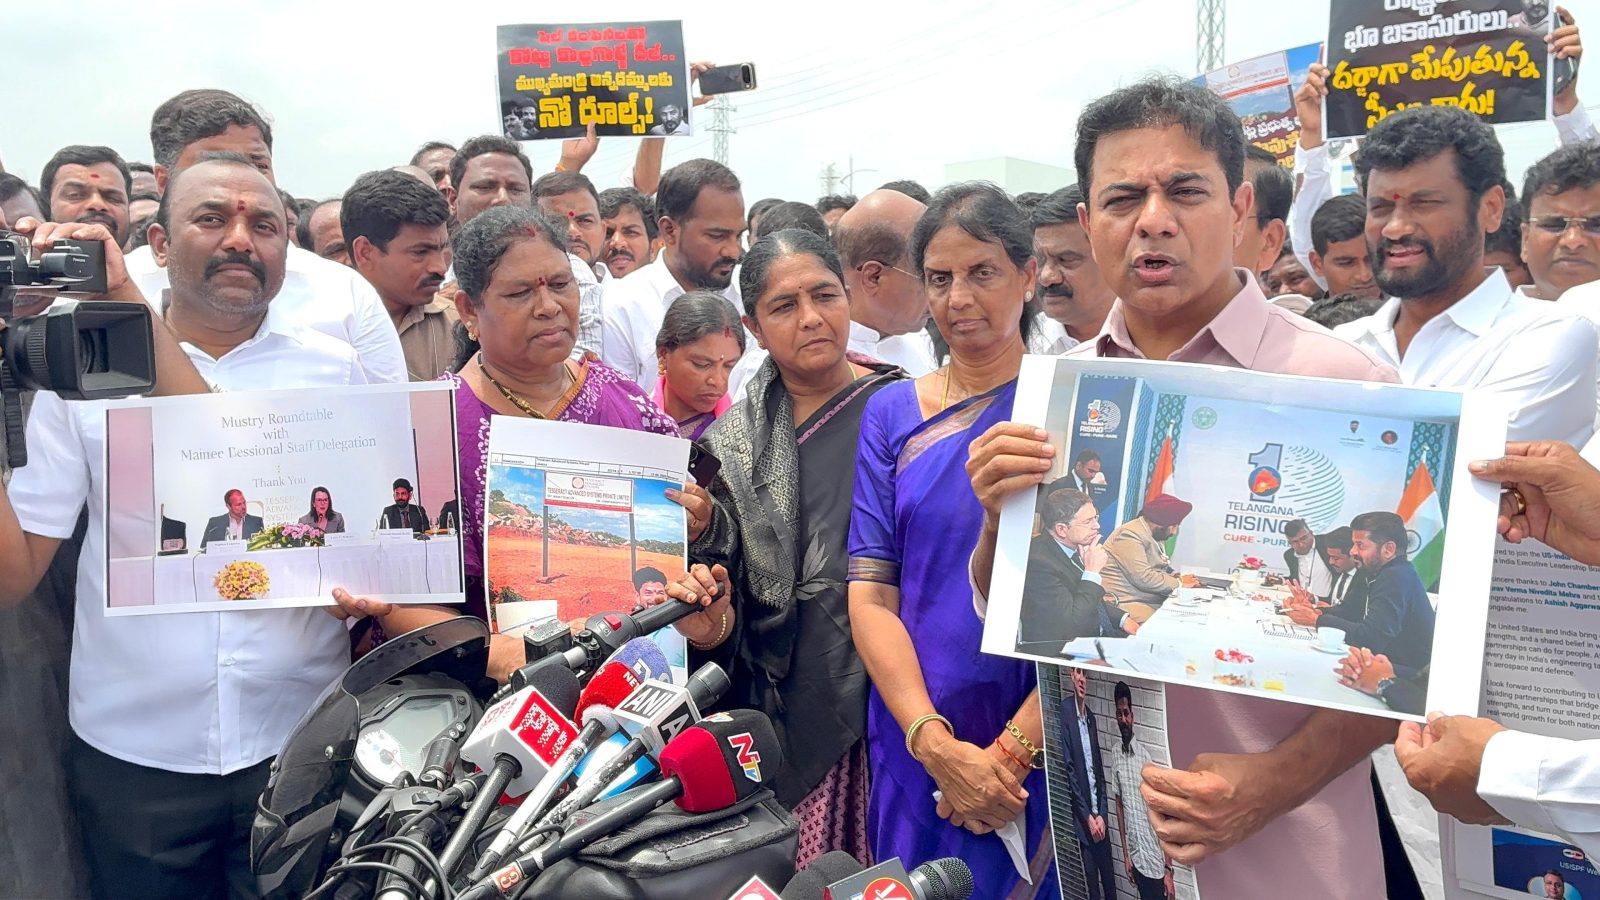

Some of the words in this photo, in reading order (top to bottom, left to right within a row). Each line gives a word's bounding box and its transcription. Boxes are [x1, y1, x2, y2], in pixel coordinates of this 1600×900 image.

[1344, 25, 1379, 53] భూ
[538, 95, 572, 128] నో
[221, 416, 264, 429] Mustry
[268, 408, 334, 425] Roundtable
[263, 427, 289, 440] with
[287, 440, 314, 454] Staff
[317, 435, 376, 452] Delegation
[252, 476, 285, 488] Thank
[287, 475, 306, 486] You
[1228, 501, 1294, 516] TELANGANA
[1223, 533, 1254, 544] CURE
[1262, 537, 1290, 547] PUR
[1517, 559, 1548, 568] Executive
[1550, 562, 1587, 572] Leadership
[1549, 580, 1566, 588] John
[1567, 582, 1600, 591] Chamber
[1544, 599, 1568, 607] Ashish
[1498, 623, 1520, 631] United
[1521, 625, 1543, 634] States
[1560, 629, 1577, 637] India
[1579, 630, 1597, 640] bring
[1485, 642, 1527, 652] partnerships
[1528, 645, 1541, 653] can
[1554, 647, 1564, 655] for
[1566, 650, 1592, 659] people.
[1541, 637, 1563, 645] shared
[1565, 639, 1585, 648] belief
[1493, 661, 1528, 671] aerospace
[1530, 665, 1543, 673] and
[1545, 667, 1576, 677] defence.
[1504, 652, 1517, 661] day
[1526, 654, 1548, 664] India's
[1550, 658, 1592, 670] engineering
[1506, 681, 1532, 691] forward
[1543, 687, 1586, 699] contributing
[624, 687, 673, 716] ANI
[1486, 689, 1513, 700] building
[1514, 693, 1558, 705] partnerships
[1559, 698, 1574, 707] that
[1576, 700, 1599, 710] bridge
[1486, 700, 1520, 709] strengths,
[1536, 705, 1550, 713] turn
[1566, 710, 1590, 719] shared
[1486, 709, 1519, 719] real-world
[1521, 714, 1545, 723] growth
[1547, 716, 1557, 724] for
[1558, 718, 1575, 727] both
[1559, 861, 1585, 872] USISPF
[1587, 867, 1599, 876] We
